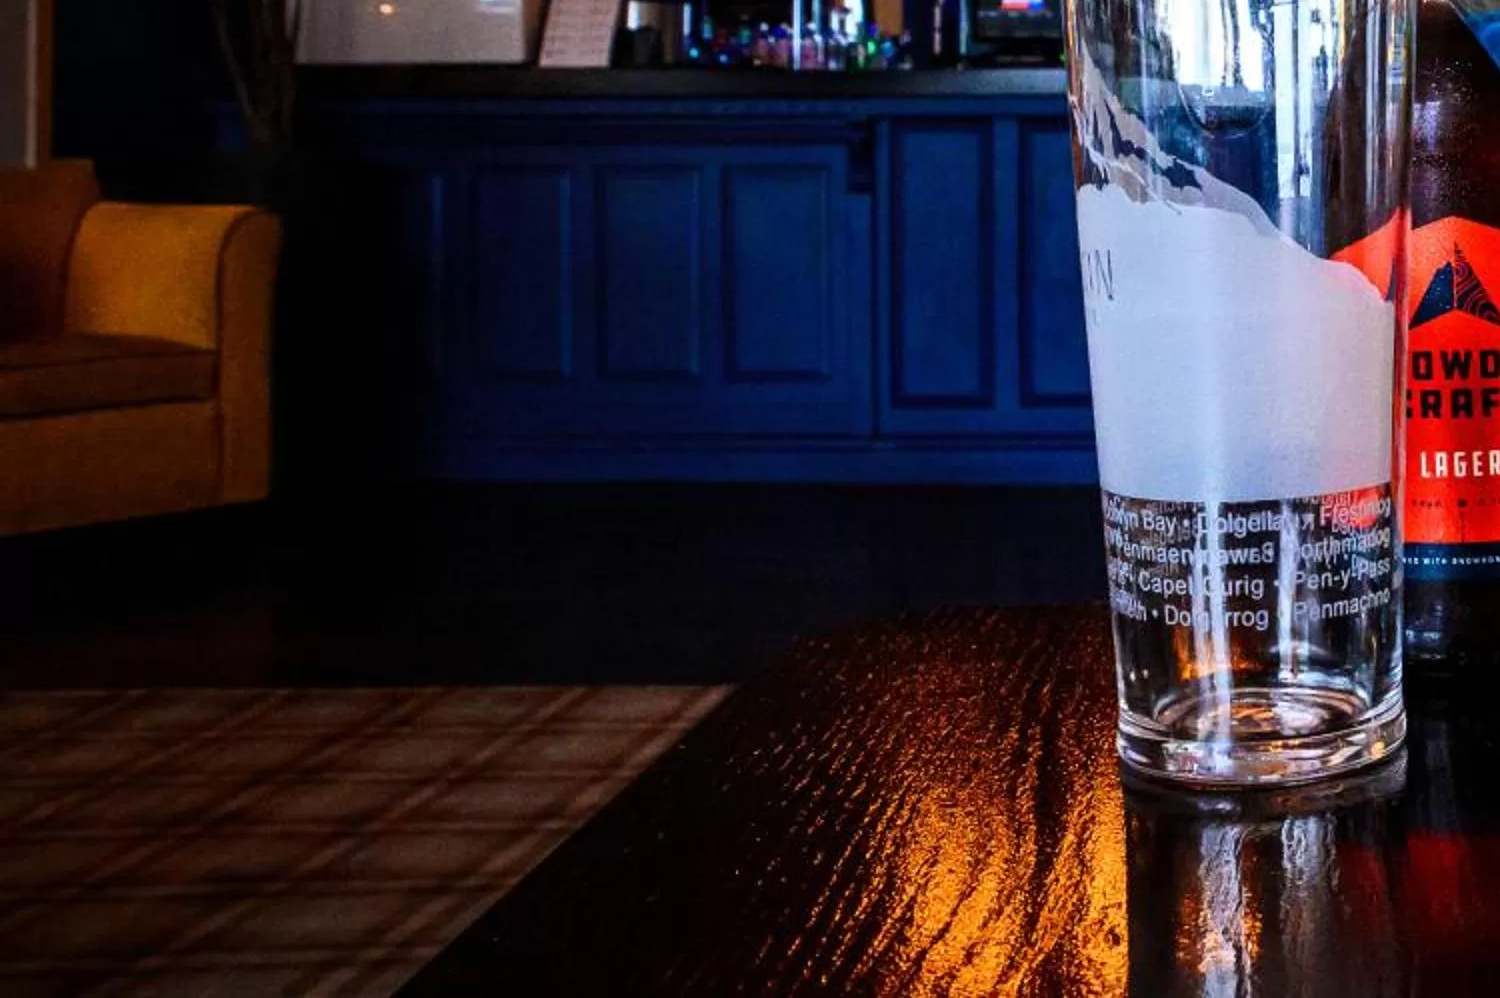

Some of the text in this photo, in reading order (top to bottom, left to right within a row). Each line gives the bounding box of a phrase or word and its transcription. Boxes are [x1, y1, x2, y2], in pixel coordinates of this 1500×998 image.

[1143, 509, 1177, 537] Bay
[1138, 568, 1193, 599] Capel
[1165, 604, 1269, 632] Dorrog
